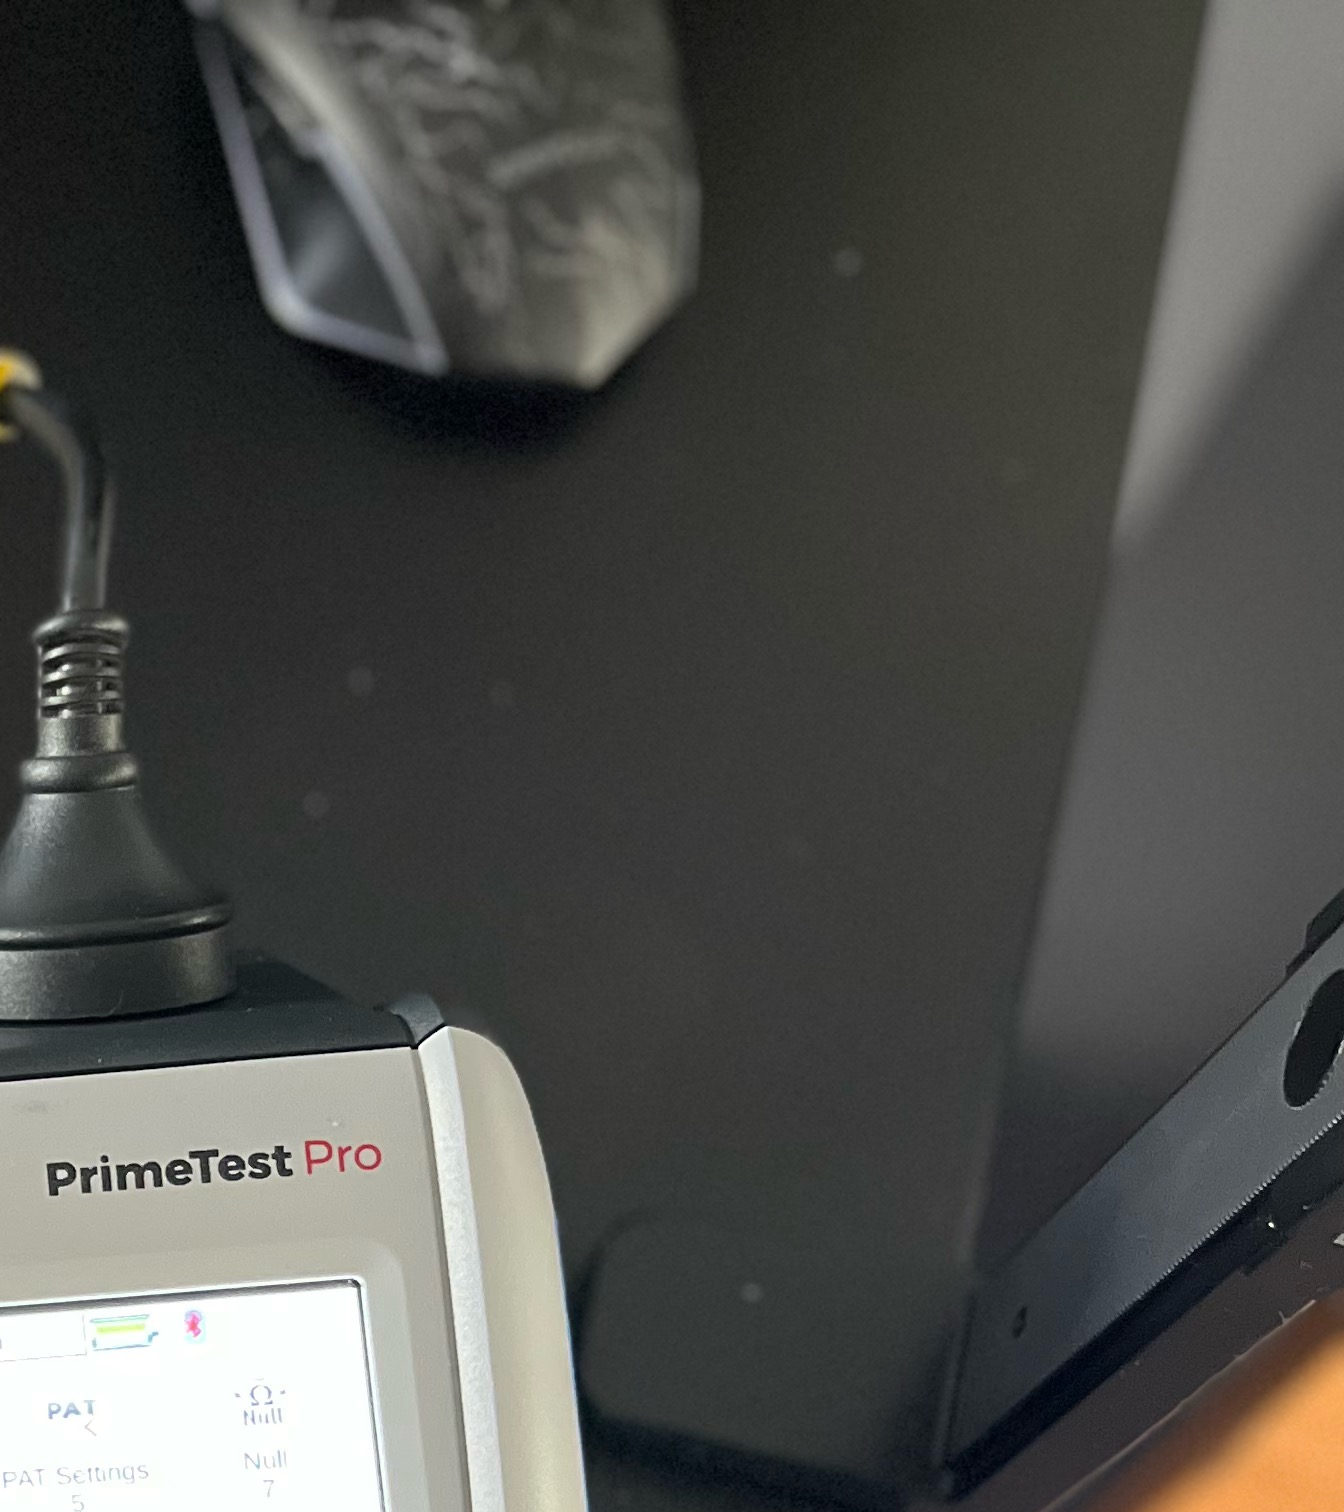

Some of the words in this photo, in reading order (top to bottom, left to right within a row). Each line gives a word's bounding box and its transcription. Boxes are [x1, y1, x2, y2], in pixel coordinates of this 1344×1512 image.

[46, 1145, 294, 1197] PrimeTest
[304, 1140, 383, 1176] Pro
[47, 1399, 97, 1421] PAT
[243, 1449, 288, 1471] Null
[2, 1468, 45, 1489] PAT
[262, 1479, 276, 1499] 7
